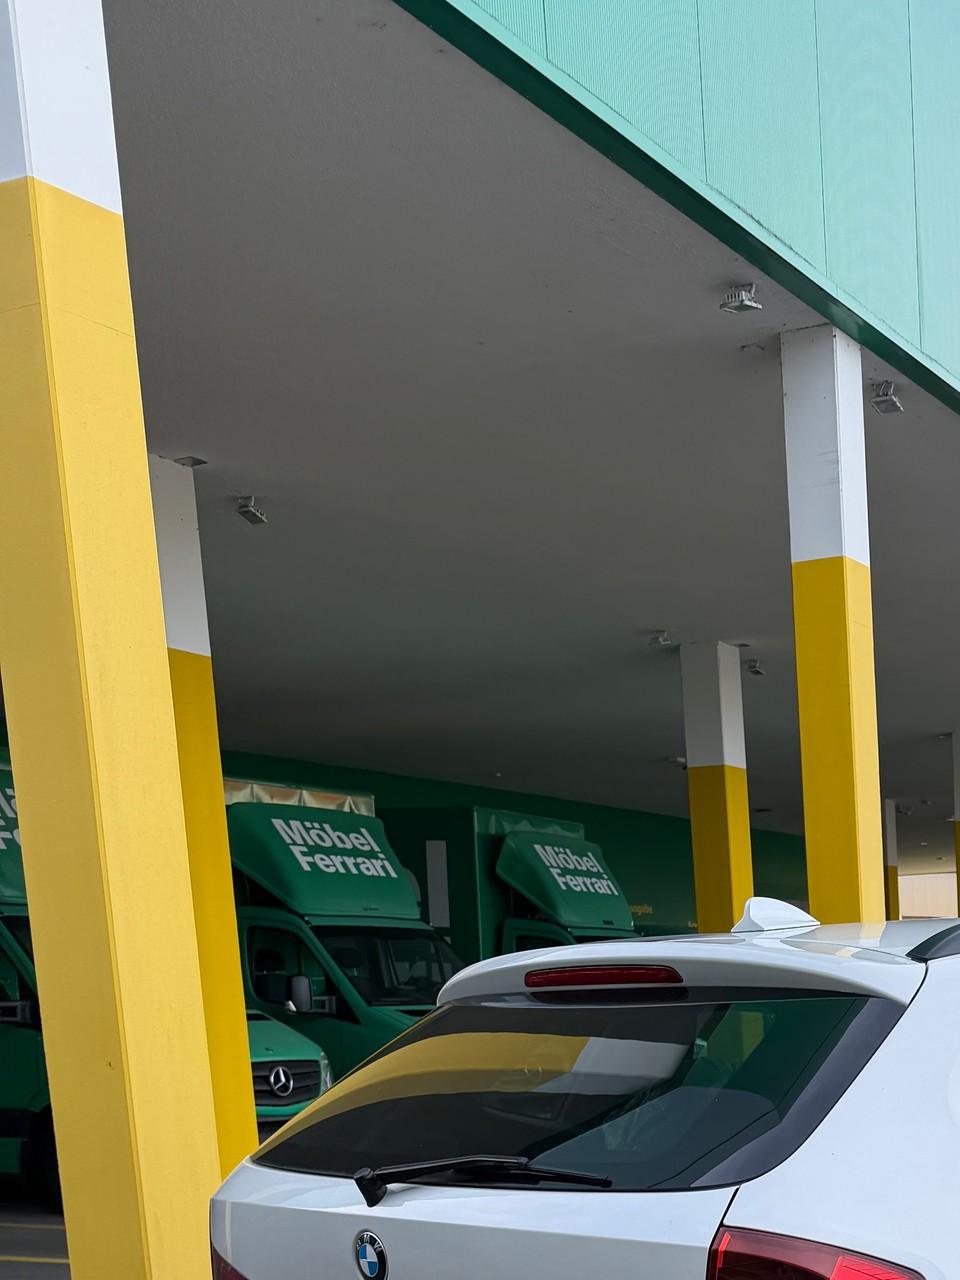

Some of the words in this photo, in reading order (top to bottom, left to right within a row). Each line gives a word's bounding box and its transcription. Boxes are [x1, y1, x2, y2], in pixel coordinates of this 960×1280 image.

[271, 818, 381, 852] Möbel
[289, 845, 398, 878] Ferrari
[533, 844, 604, 873] Möbel
[549, 867, 619, 896] Ferrari
[356, 1233, 384, 1253] BMW
